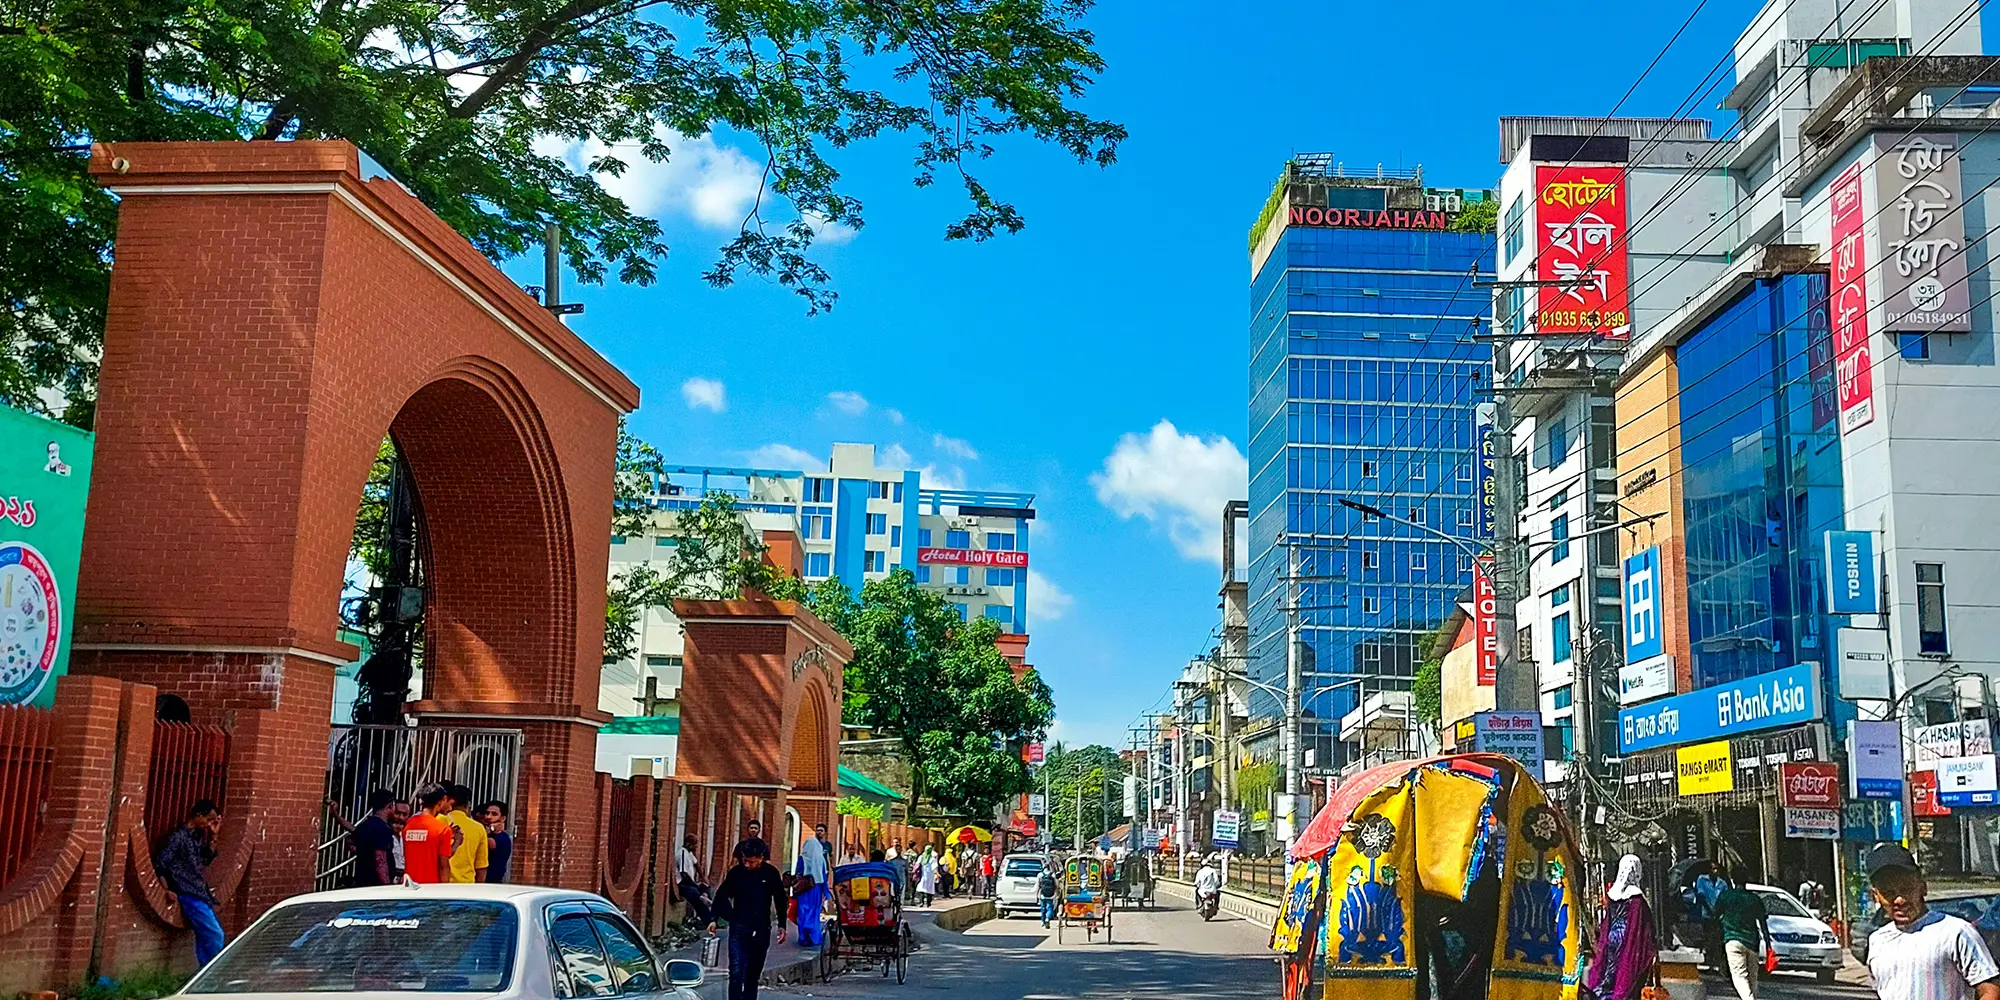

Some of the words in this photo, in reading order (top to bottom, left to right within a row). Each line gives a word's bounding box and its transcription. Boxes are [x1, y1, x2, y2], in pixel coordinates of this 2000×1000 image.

[1542, 175, 1618, 210] হোটেল
[1288, 207, 1446, 229] NOORJAHAN
[1544, 211, 1617, 259] হলি
[1551, 258, 1612, 305] ইন
[1541, 310, 1577, 328] 01935
[921, 549, 961, 562] Hotel
[965, 550, 993, 565] Holy
[996, 552, 1024, 565] Gate
[1845, 542, 1861, 600] TOSHIN
[1480, 581, 1496, 670] HOTEL
[1735, 683, 1771, 723] Bank
[1772, 676, 1805, 716] Asia
[1680, 760, 1703, 777] RANGS
[1704, 757, 1727, 774] eMART
[1790, 809, 1836, 821] HASAN'S
